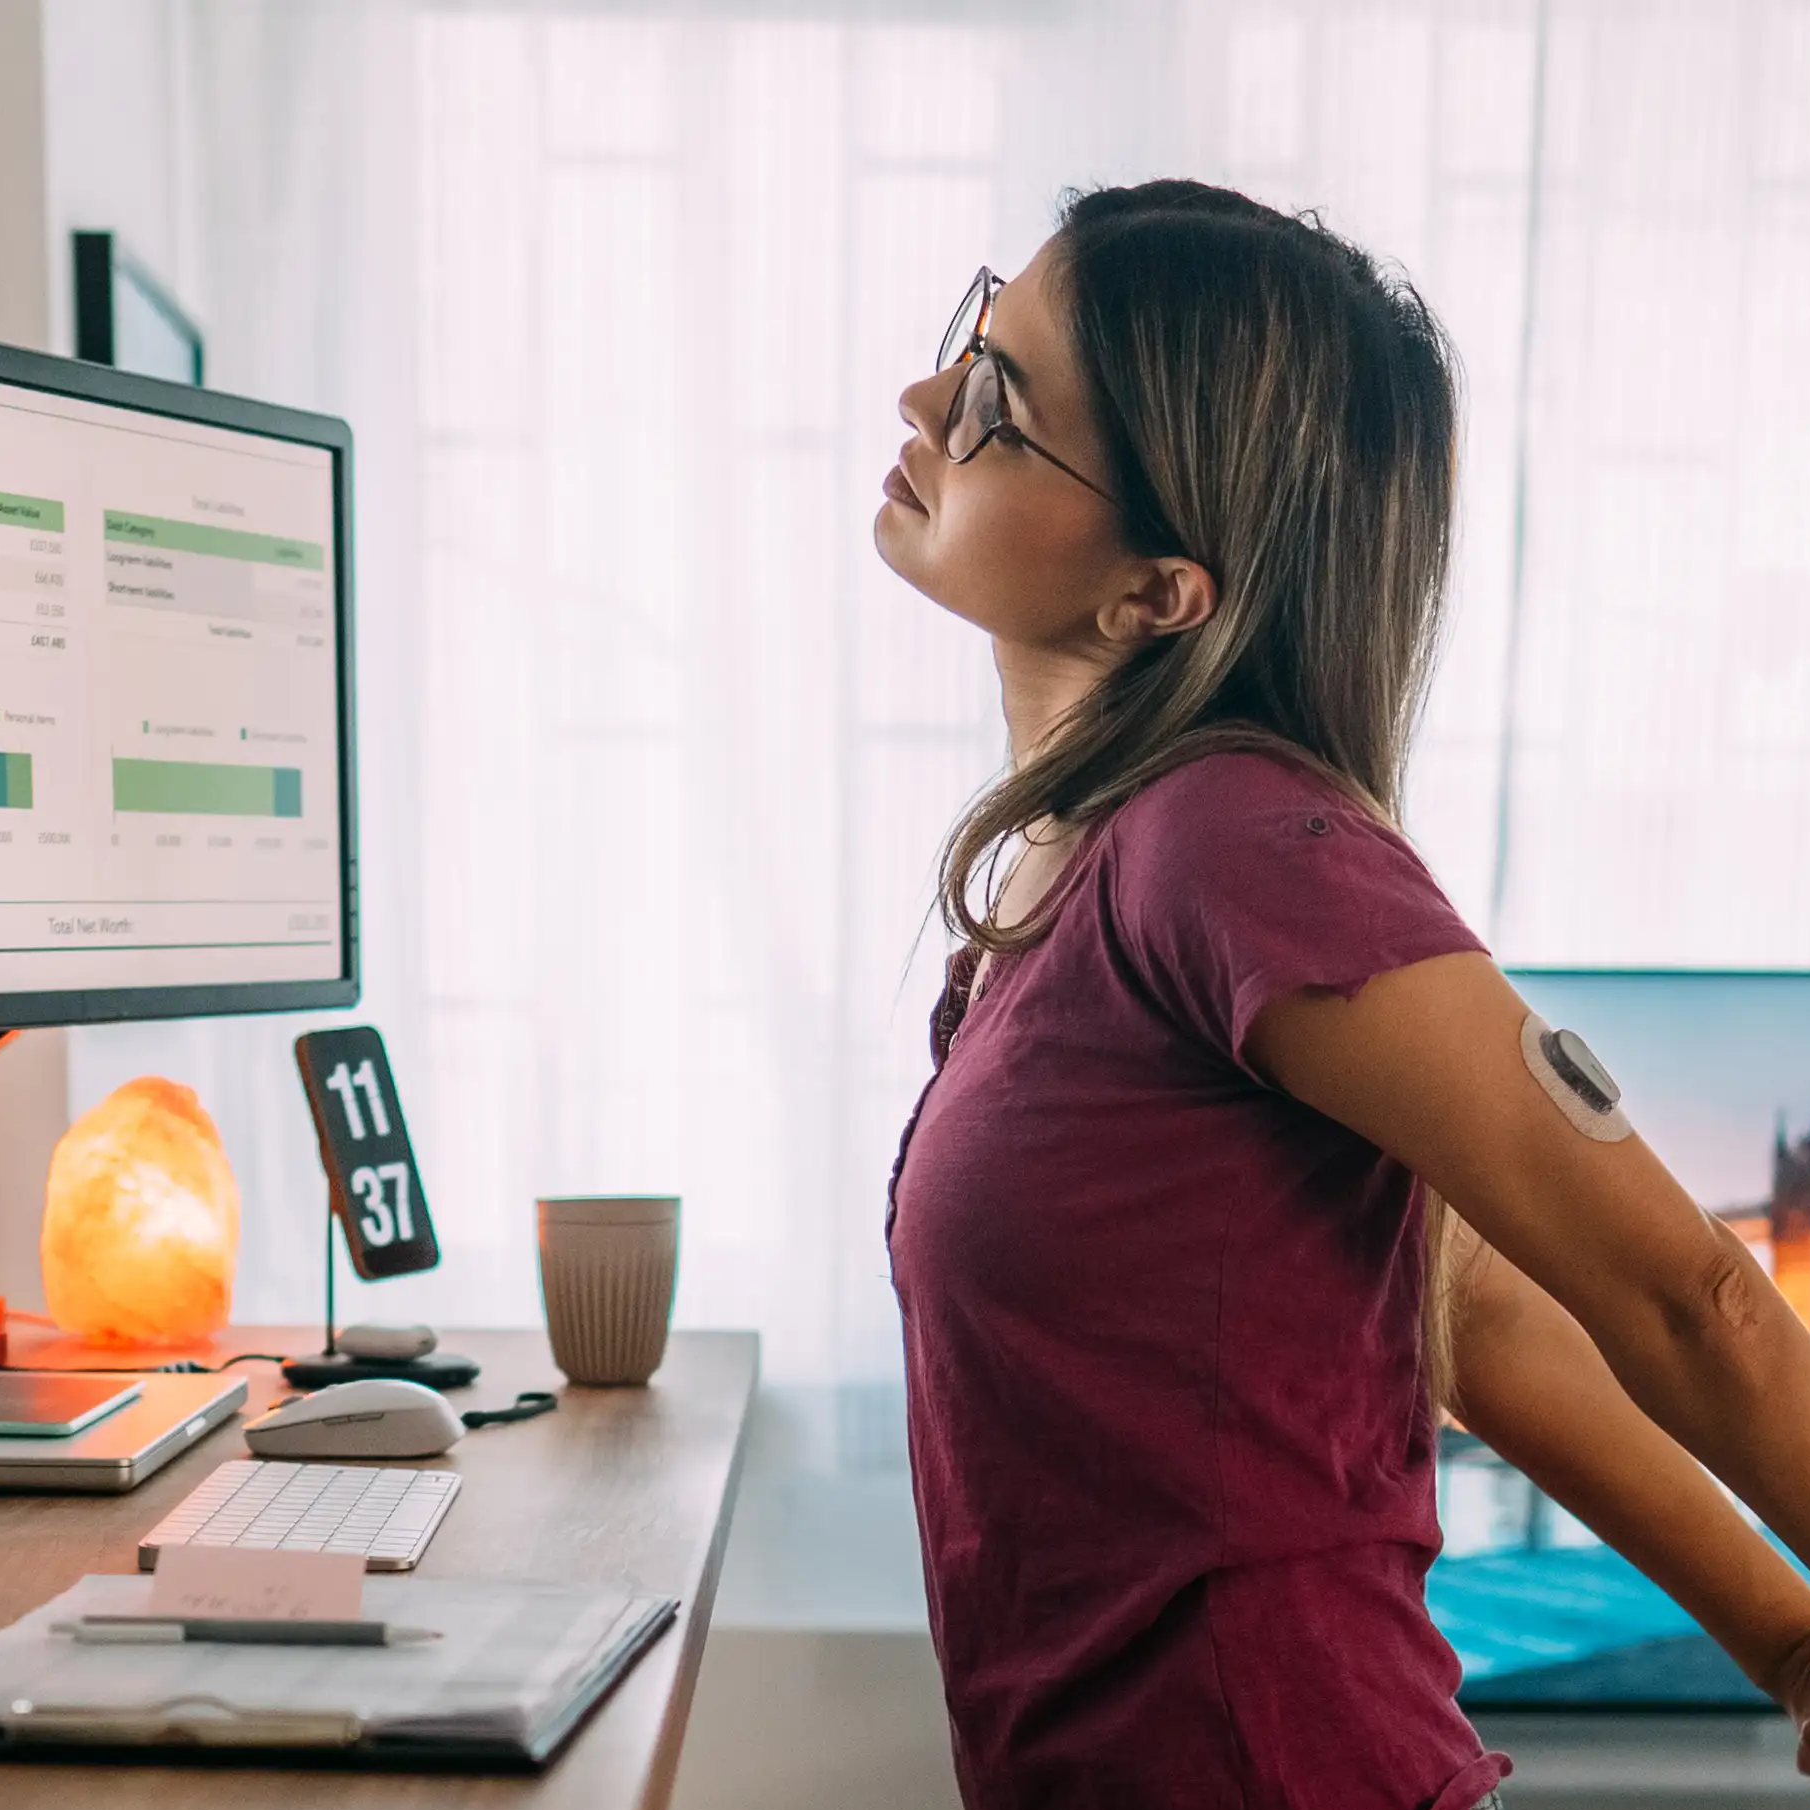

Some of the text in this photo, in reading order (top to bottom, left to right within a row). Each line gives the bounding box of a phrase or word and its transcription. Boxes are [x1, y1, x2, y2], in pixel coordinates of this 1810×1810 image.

[48, 916, 75, 935] Total
[326, 1059, 391, 1141] 11
[351, 1162, 411, 1247] 37
